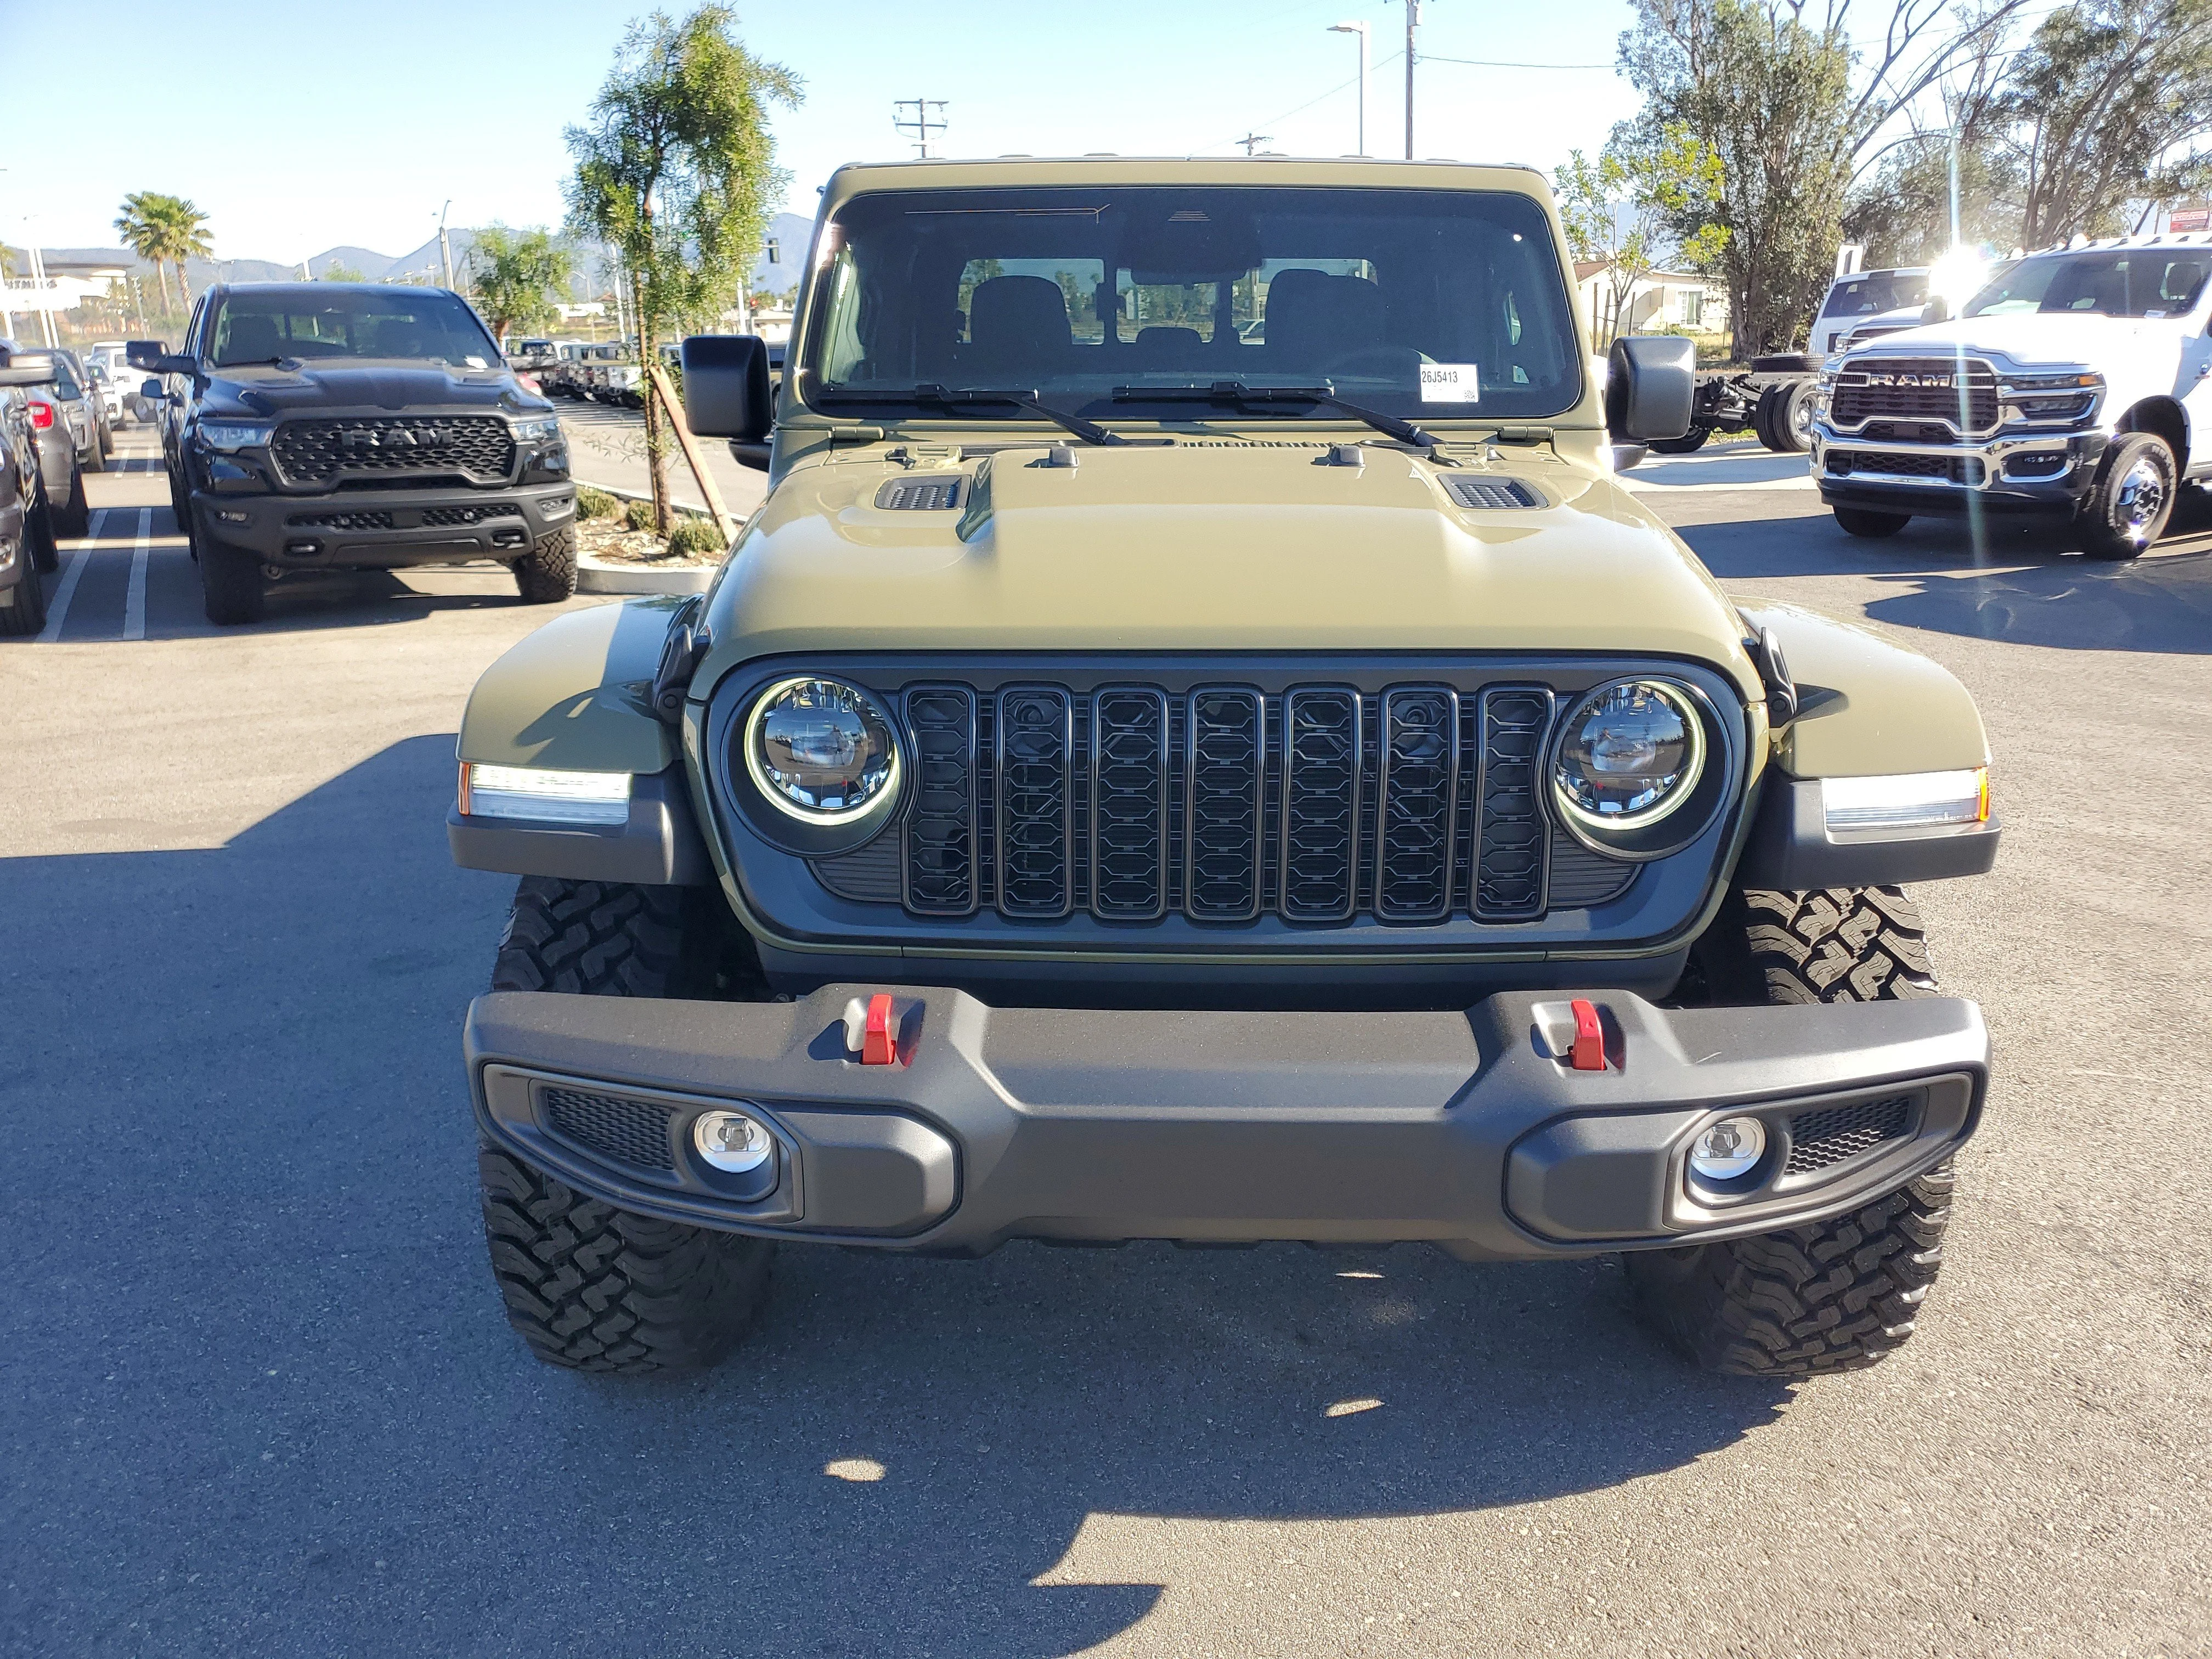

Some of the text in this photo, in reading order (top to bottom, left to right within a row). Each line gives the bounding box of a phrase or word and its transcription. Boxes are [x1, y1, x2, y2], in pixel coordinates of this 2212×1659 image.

[1421, 370, 1458, 383] 26J5413
[1870, 374, 1950, 387] RAM
[341, 428, 452, 445] RAM
